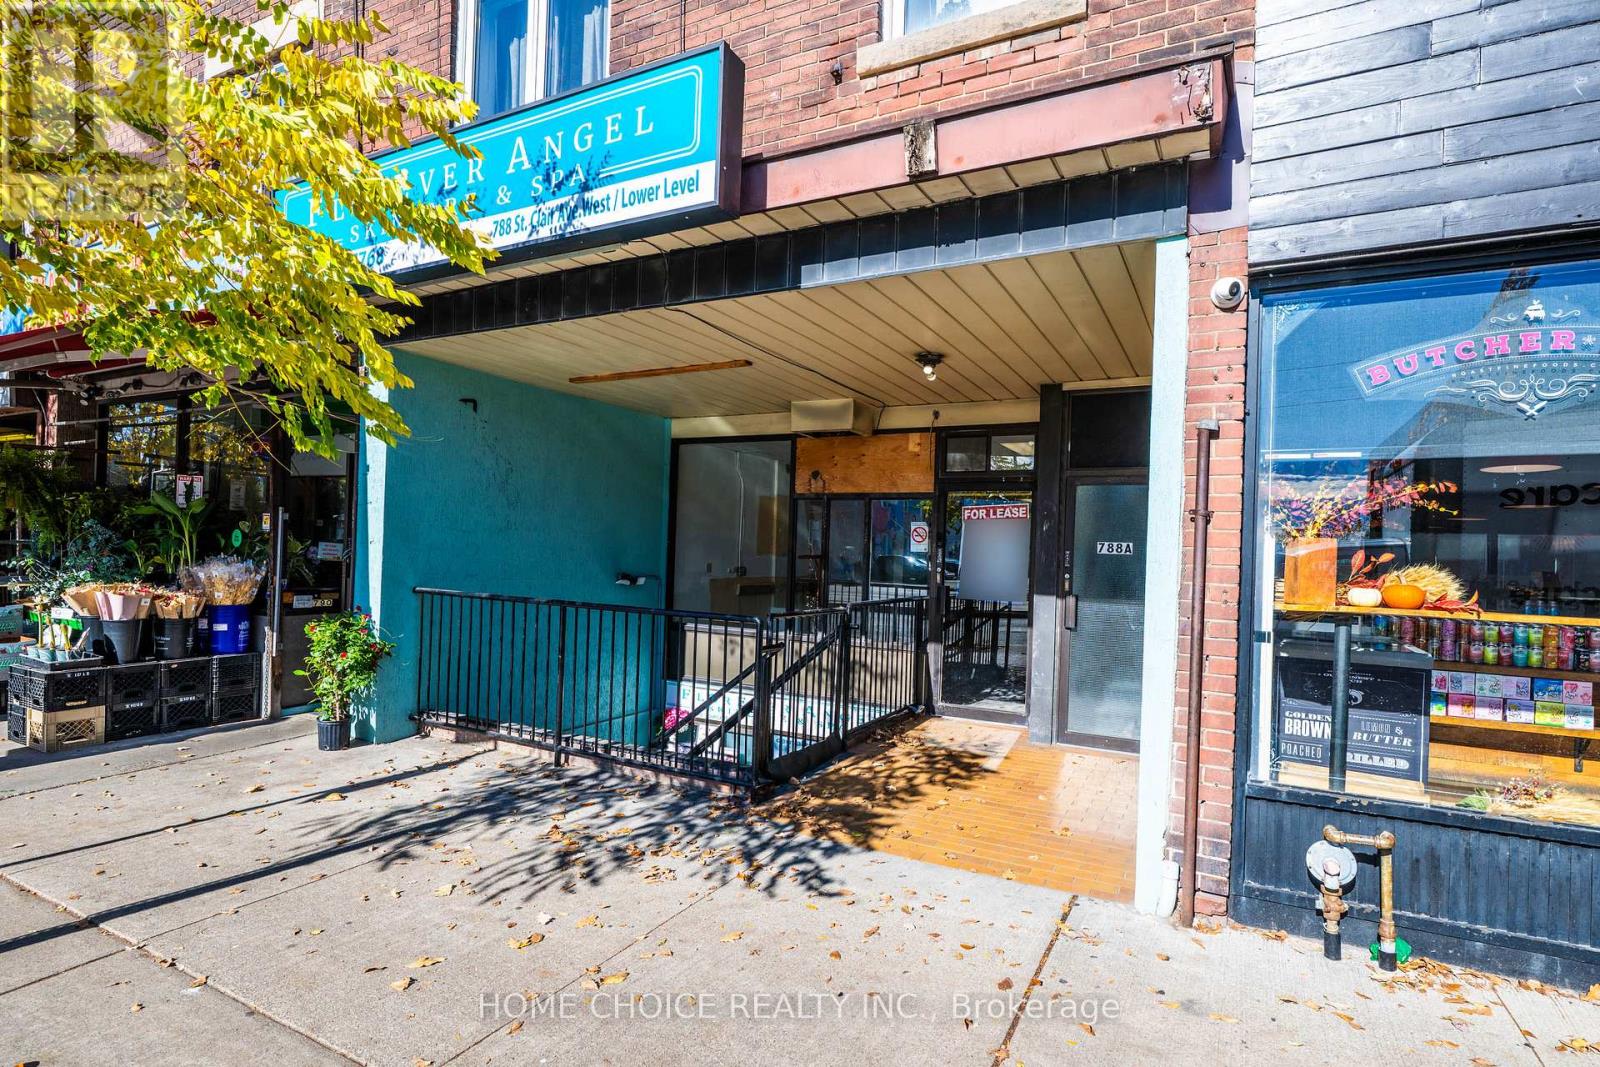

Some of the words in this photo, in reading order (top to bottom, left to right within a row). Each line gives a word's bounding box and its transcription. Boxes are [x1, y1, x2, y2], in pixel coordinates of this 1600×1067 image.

[507, 105, 654, 174] ANGEL
[496, 185, 512, 205] &
[531, 163, 586, 196] SPA
[492, 219, 512, 238] 788
[514, 213, 528, 232] St.
[530, 203, 555, 228] Clair
[582, 196, 610, 218] West
[621, 184, 661, 209] Lower
[664, 169, 700, 199] Level
[1367, 330, 1576, 386] BUTCHER
[964, 508, 987, 520] FOR
[989, 506, 1028, 519] LEASE
[1098, 542, 1133, 554] 788A
[1284, 718, 1332, 739] BROWN
[1352, 731, 1413, 748] BUTTER
[1281, 742, 1322, 759] POACHED
[1346, 752, 1411, 770] RILLED
